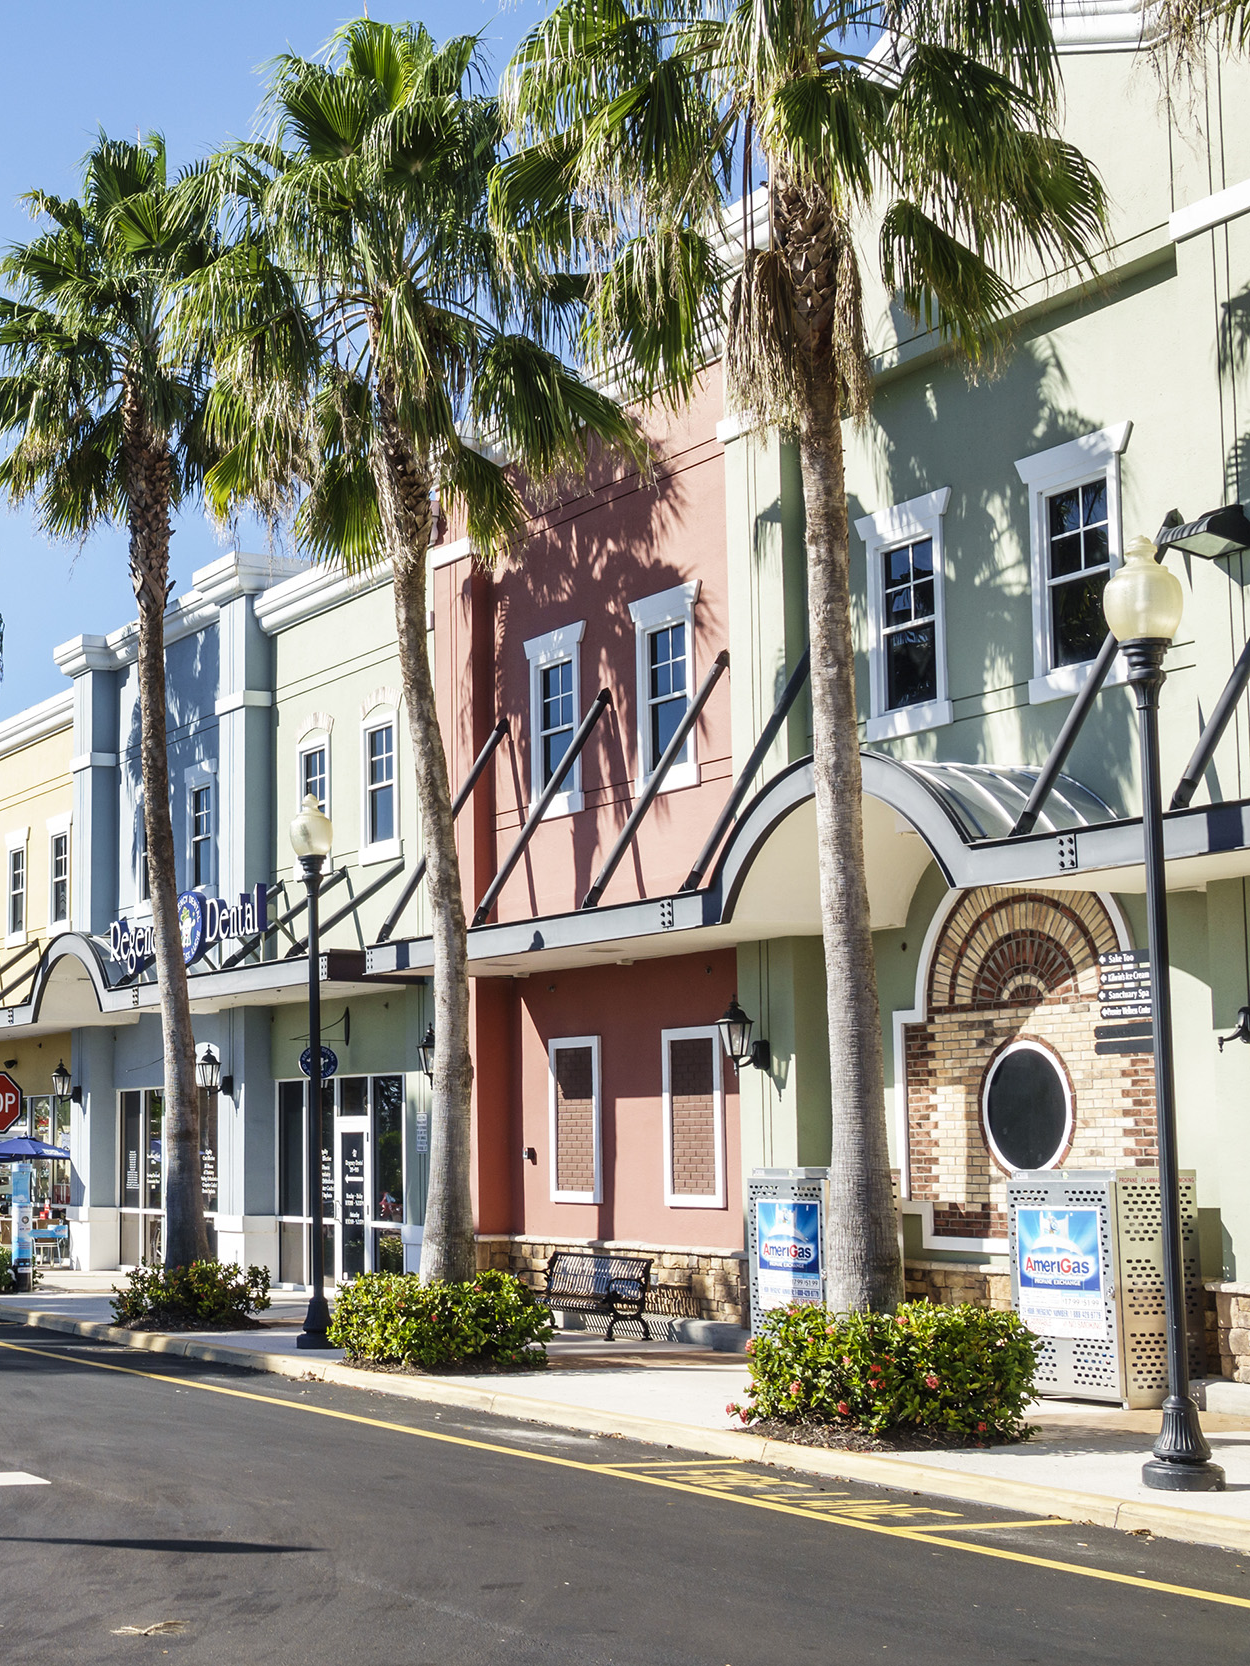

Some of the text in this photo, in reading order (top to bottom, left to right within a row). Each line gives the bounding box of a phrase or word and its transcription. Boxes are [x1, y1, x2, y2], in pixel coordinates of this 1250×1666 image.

[110, 883, 260, 975] Regenc Dental
[1108, 953, 1135, 964] Sake Too
[1133, 970, 1150, 980] Cream
[1108, 988, 1150, 1000] Sanctuary Spa
[763, 1243, 811, 1259] AmeriGas
[1025, 1257, 1090, 1274] AmeriGas
[1033, 1277, 1082, 1287] PROPANE EXCHANGE
[753, 1492, 963, 1520] LANE
